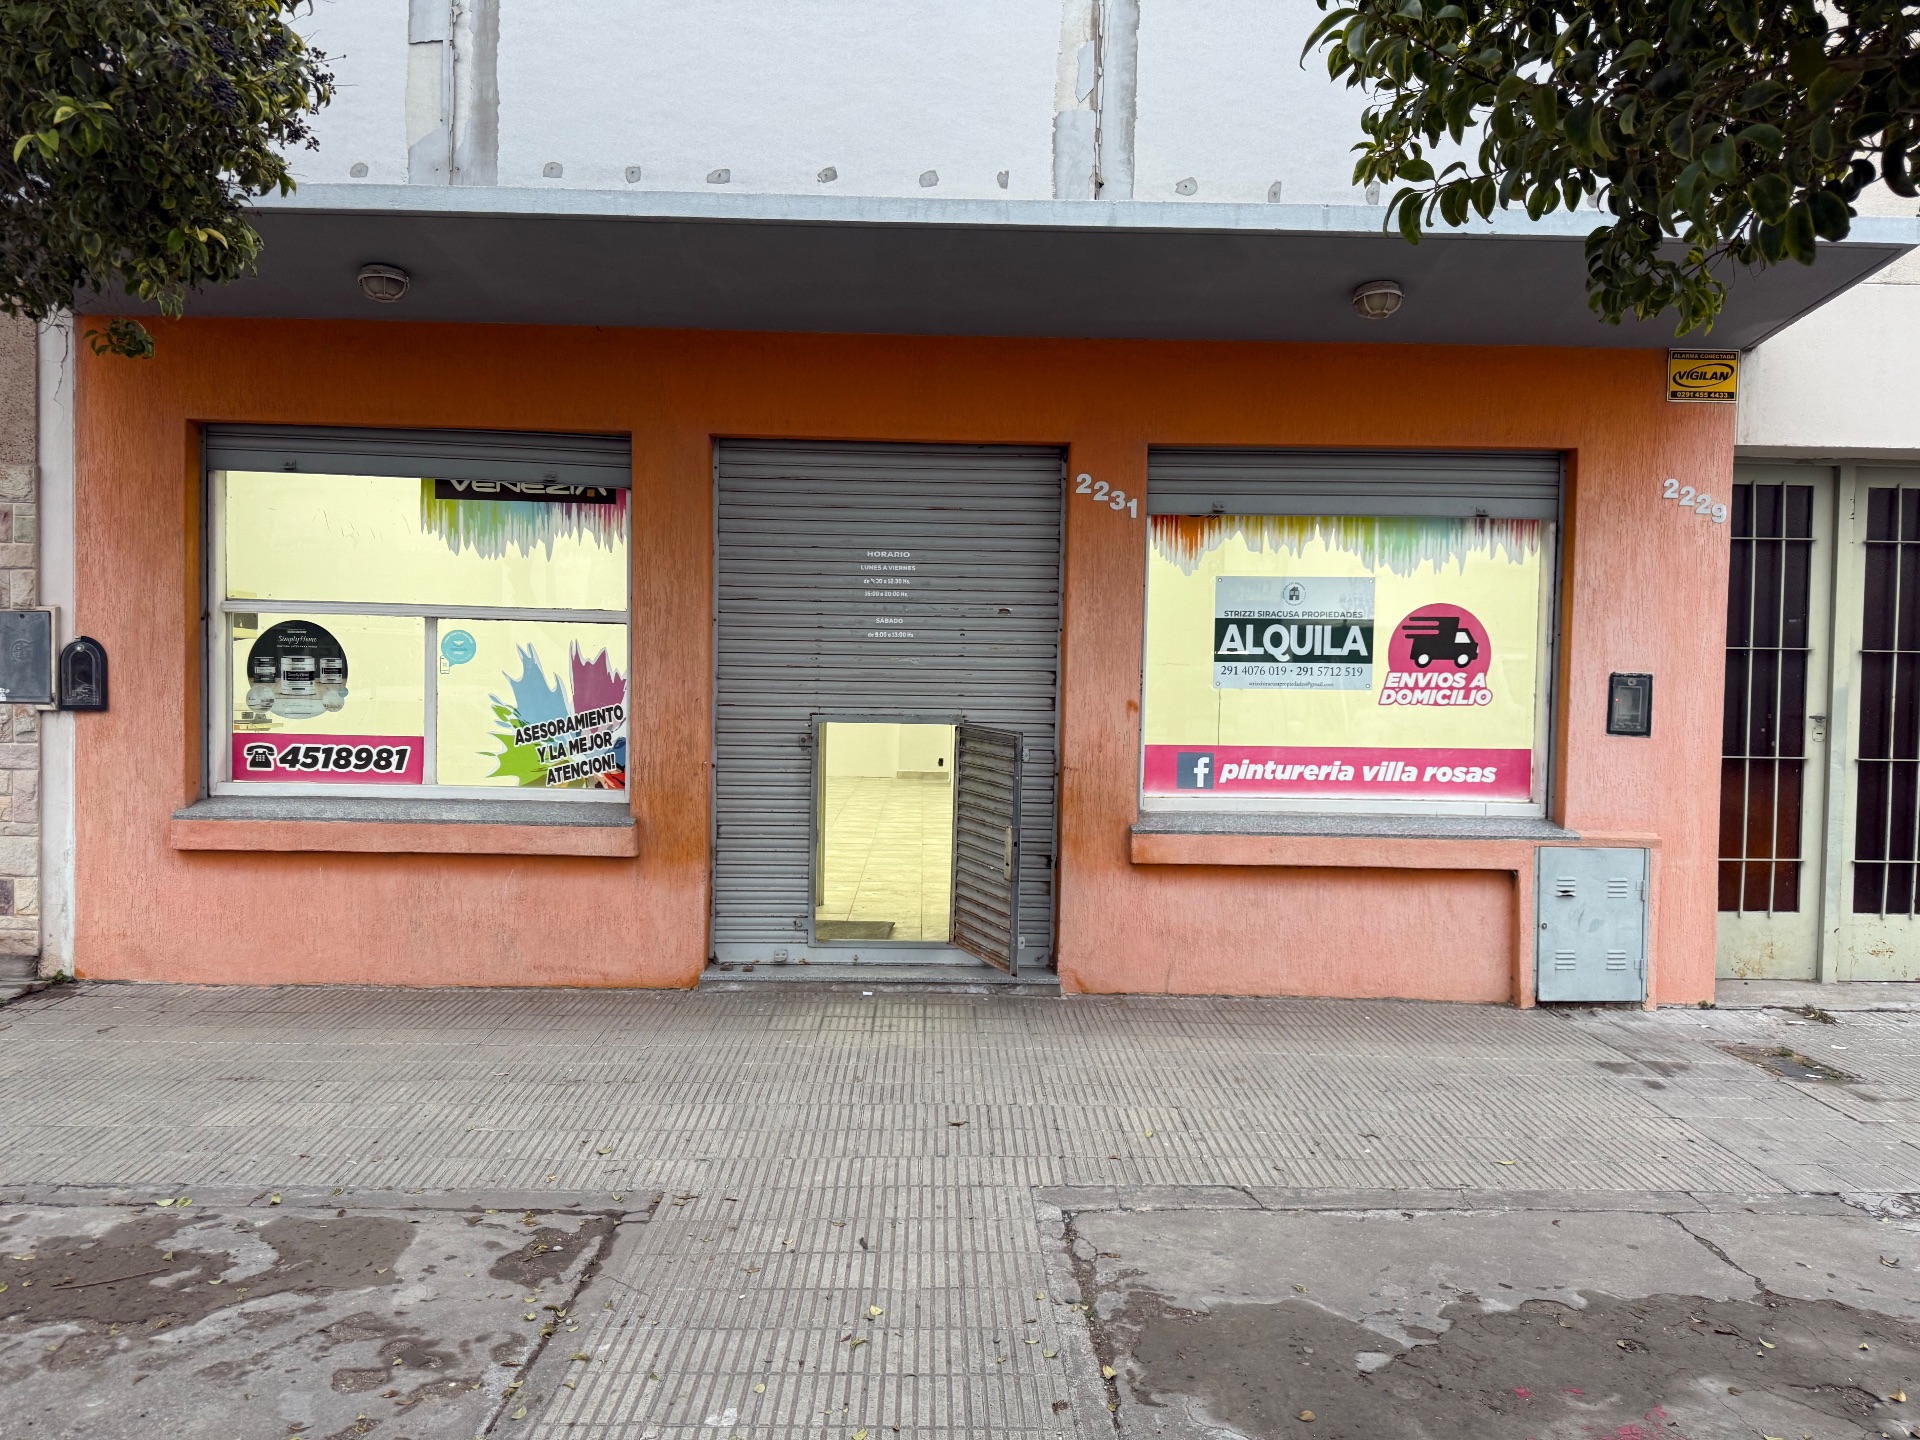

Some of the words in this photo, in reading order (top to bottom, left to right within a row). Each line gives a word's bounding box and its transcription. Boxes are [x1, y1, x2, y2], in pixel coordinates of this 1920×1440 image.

[1677, 370, 1729, 381] VIGILAN
[1075, 473, 1138, 519] 2231
[1663, 478, 1727, 524] 2229
[1224, 610, 1255, 618] STRIZZI
[1302, 611, 1363, 619] PROPIEDADES
[1217, 624, 1369, 662] ALQUILA
[1220, 666, 1239, 676] 291
[1242, 666, 1266, 676] 4076
[1268, 666, 1287, 676] 019
[1296, 666, 1314, 677] 291
[1317, 666, 1342, 677] 5712
[1344, 667, 1363, 677] 519
[1384, 671, 1468, 688] ENVIOS
[1468, 672, 1486, 688] A
[1379, 688, 1492, 705] DOMICILIO
[514, 704, 624, 746] ASESORAMIENTO
[278, 746, 409, 771] 4518981
[536, 746, 546, 763] Y
[549, 742, 567, 761] LA
[568, 731, 613, 756] MEJOR
[546, 753, 616, 786] ATENCION!
[1193, 757, 1210, 788] f
[1219, 759, 1354, 783] pintureria
[1362, 761, 1418, 782] villa
[1423, 764, 1497, 783] rosas
